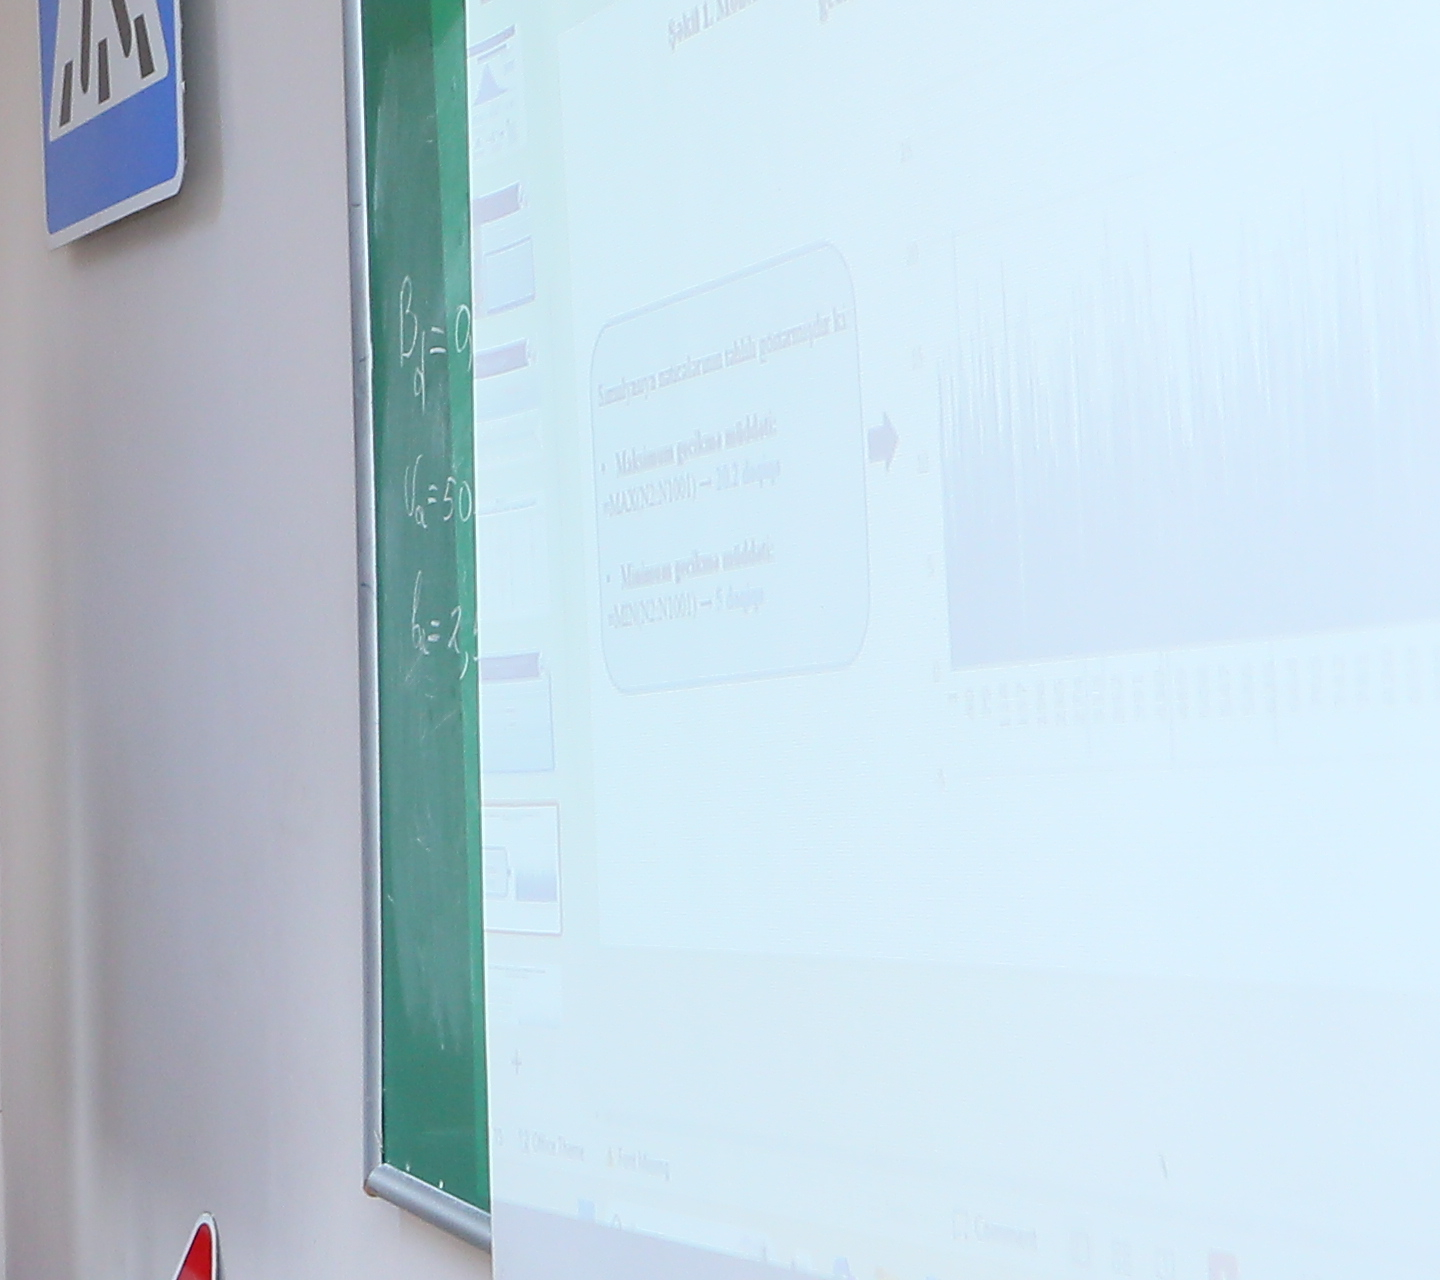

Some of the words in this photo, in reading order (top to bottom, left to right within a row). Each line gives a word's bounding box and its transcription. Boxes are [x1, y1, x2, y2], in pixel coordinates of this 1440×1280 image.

[667, 3, 700, 53] Şəkil
[615, 444, 674, 477] Maksimum
[620, 561, 672, 590] Minimum
